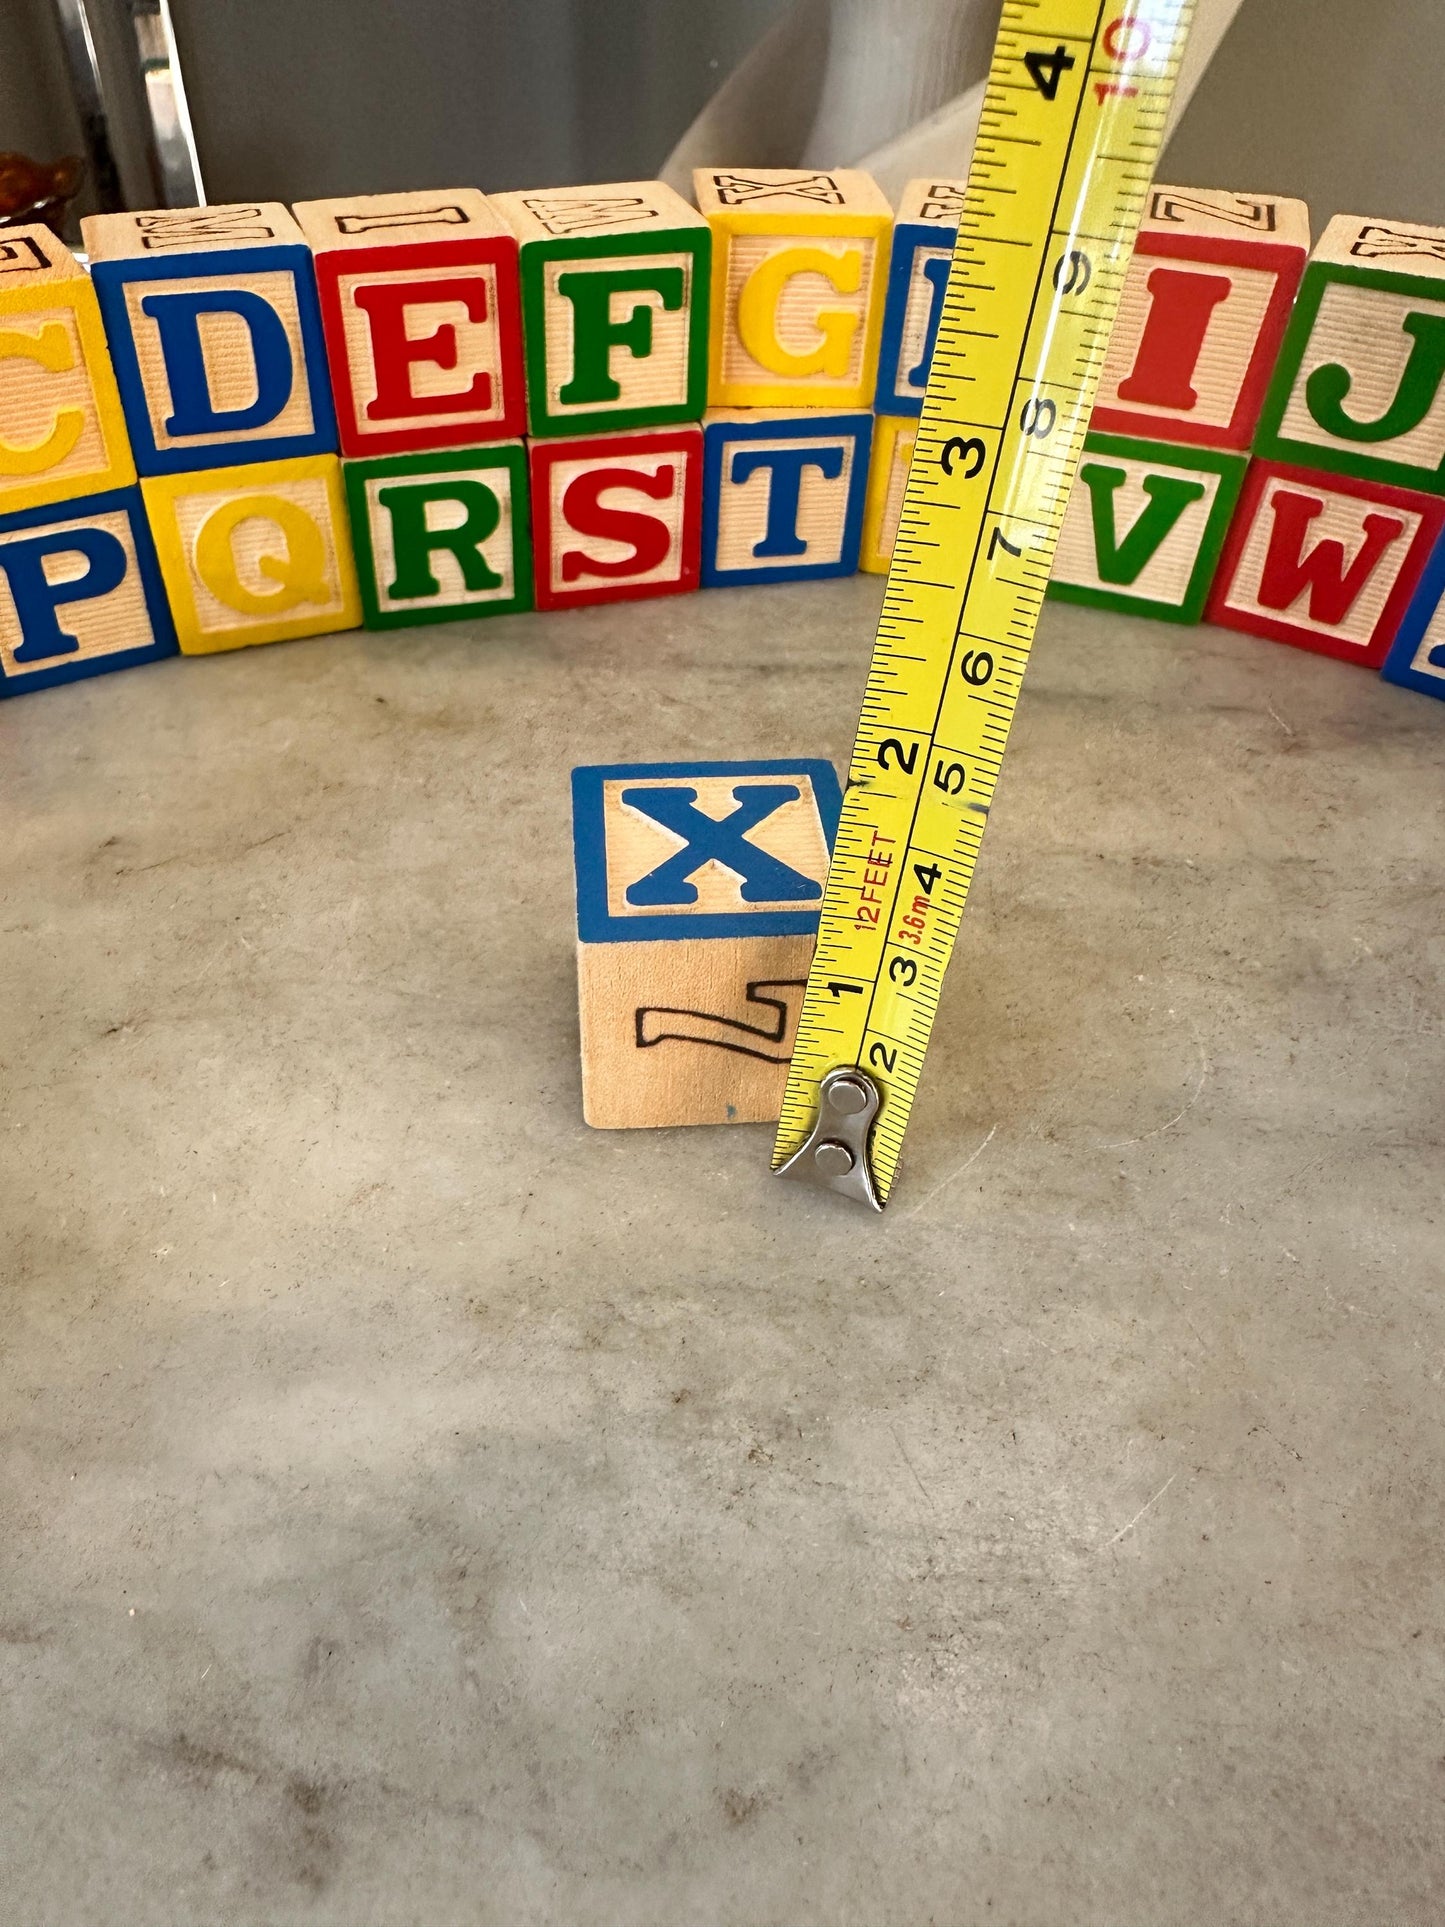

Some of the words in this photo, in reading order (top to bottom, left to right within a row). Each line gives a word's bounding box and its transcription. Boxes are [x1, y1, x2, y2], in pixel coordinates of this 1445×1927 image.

[1023, 45, 1076, 101] 4
[1094, 16, 1151, 107] 10
[712, 175, 846, 205] X
[738, 247, 863, 377] G
[1052, 250, 1092, 297] 9
[140, 289, 294, 437] D
[353, 277, 492, 421] E
[557, 266, 685, 405] F
[1117, 267, 1232, 411] I
[1305, 310, 1445, 443] J
[0, 322, 85, 475] C
[1019, 397, 1057, 440] 8
[731, 446, 845, 558] T
[940, 436, 987, 480] 3
[195, 494, 331, 616] Q
[377, 479, 504, 600] R
[561, 464, 675, 583] S
[986, 526, 1022, 562] 7
[1080, 462, 1206, 586] V
[1256, 489, 1405, 626] W
[0, 527, 128, 663] P
[960, 649, 995, 686] 6
[876, 738, 920, 776] 2
[933, 759, 966, 795] 5
[621, 784, 824, 907] X
[913, 862, 943, 895] 4
[898, 895, 931, 945] 3.6m
[828, 981, 865, 999] 1
[889, 956, 918, 987] 3
[869, 1042, 899, 1072] 2
